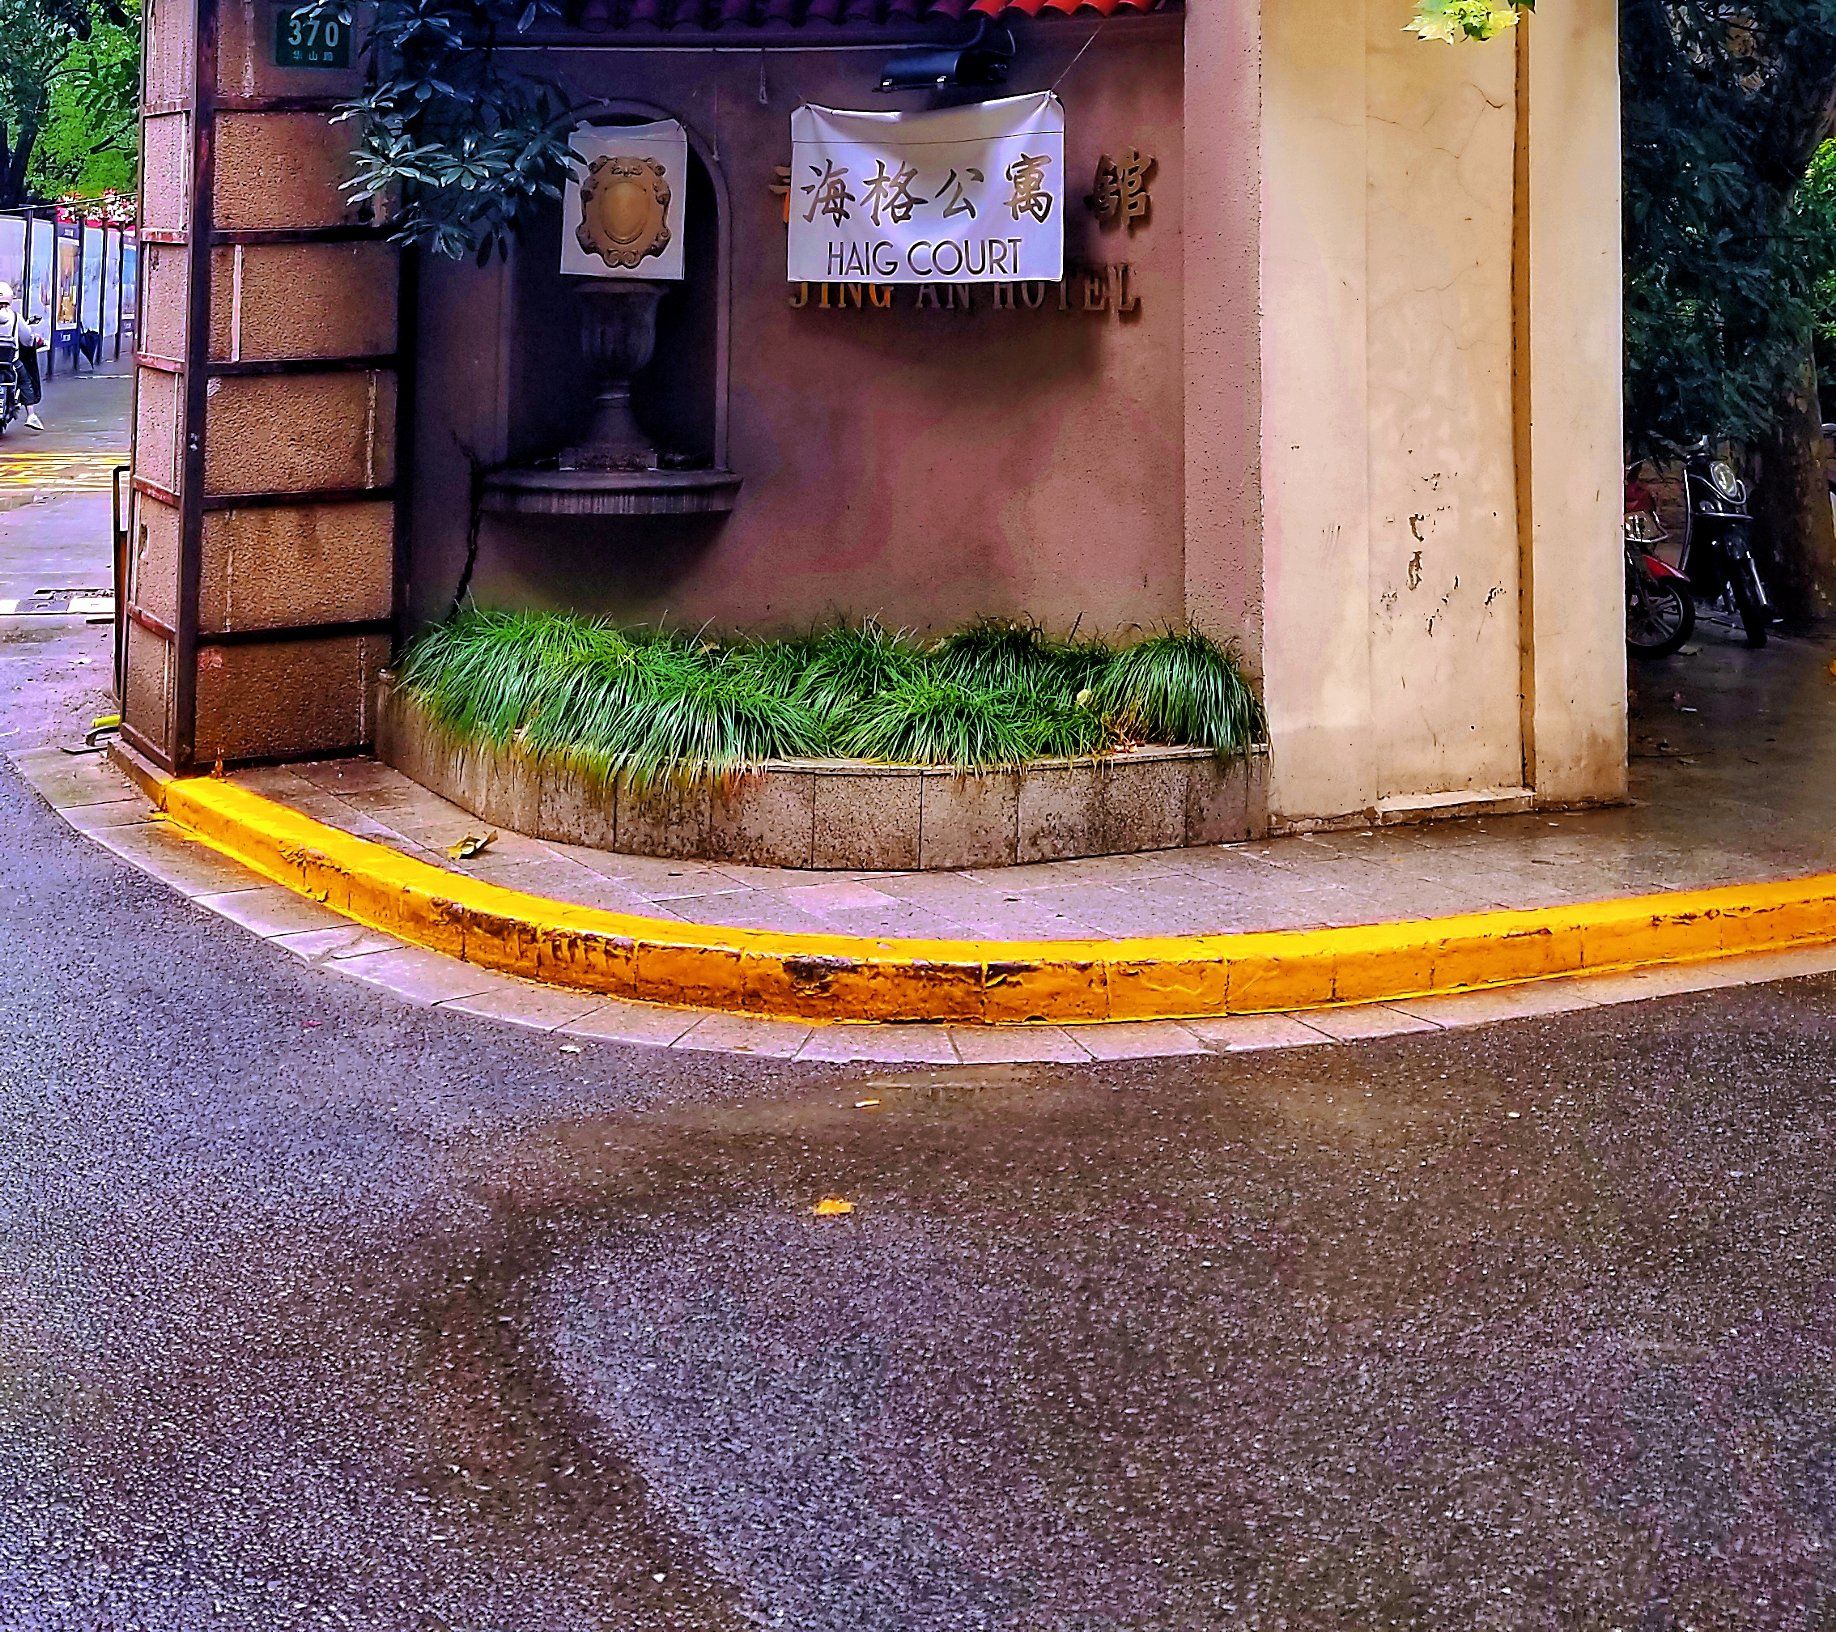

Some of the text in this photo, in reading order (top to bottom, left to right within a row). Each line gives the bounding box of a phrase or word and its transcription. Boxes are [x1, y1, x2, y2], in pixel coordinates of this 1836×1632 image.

[288, 19, 339, 47] 370
[800, 153, 1055, 227] 海格公寓
[827, 238, 1022, 276] HAIG COURT
[788, 280, 892, 309] JING
[915, 280, 971, 309] AN
